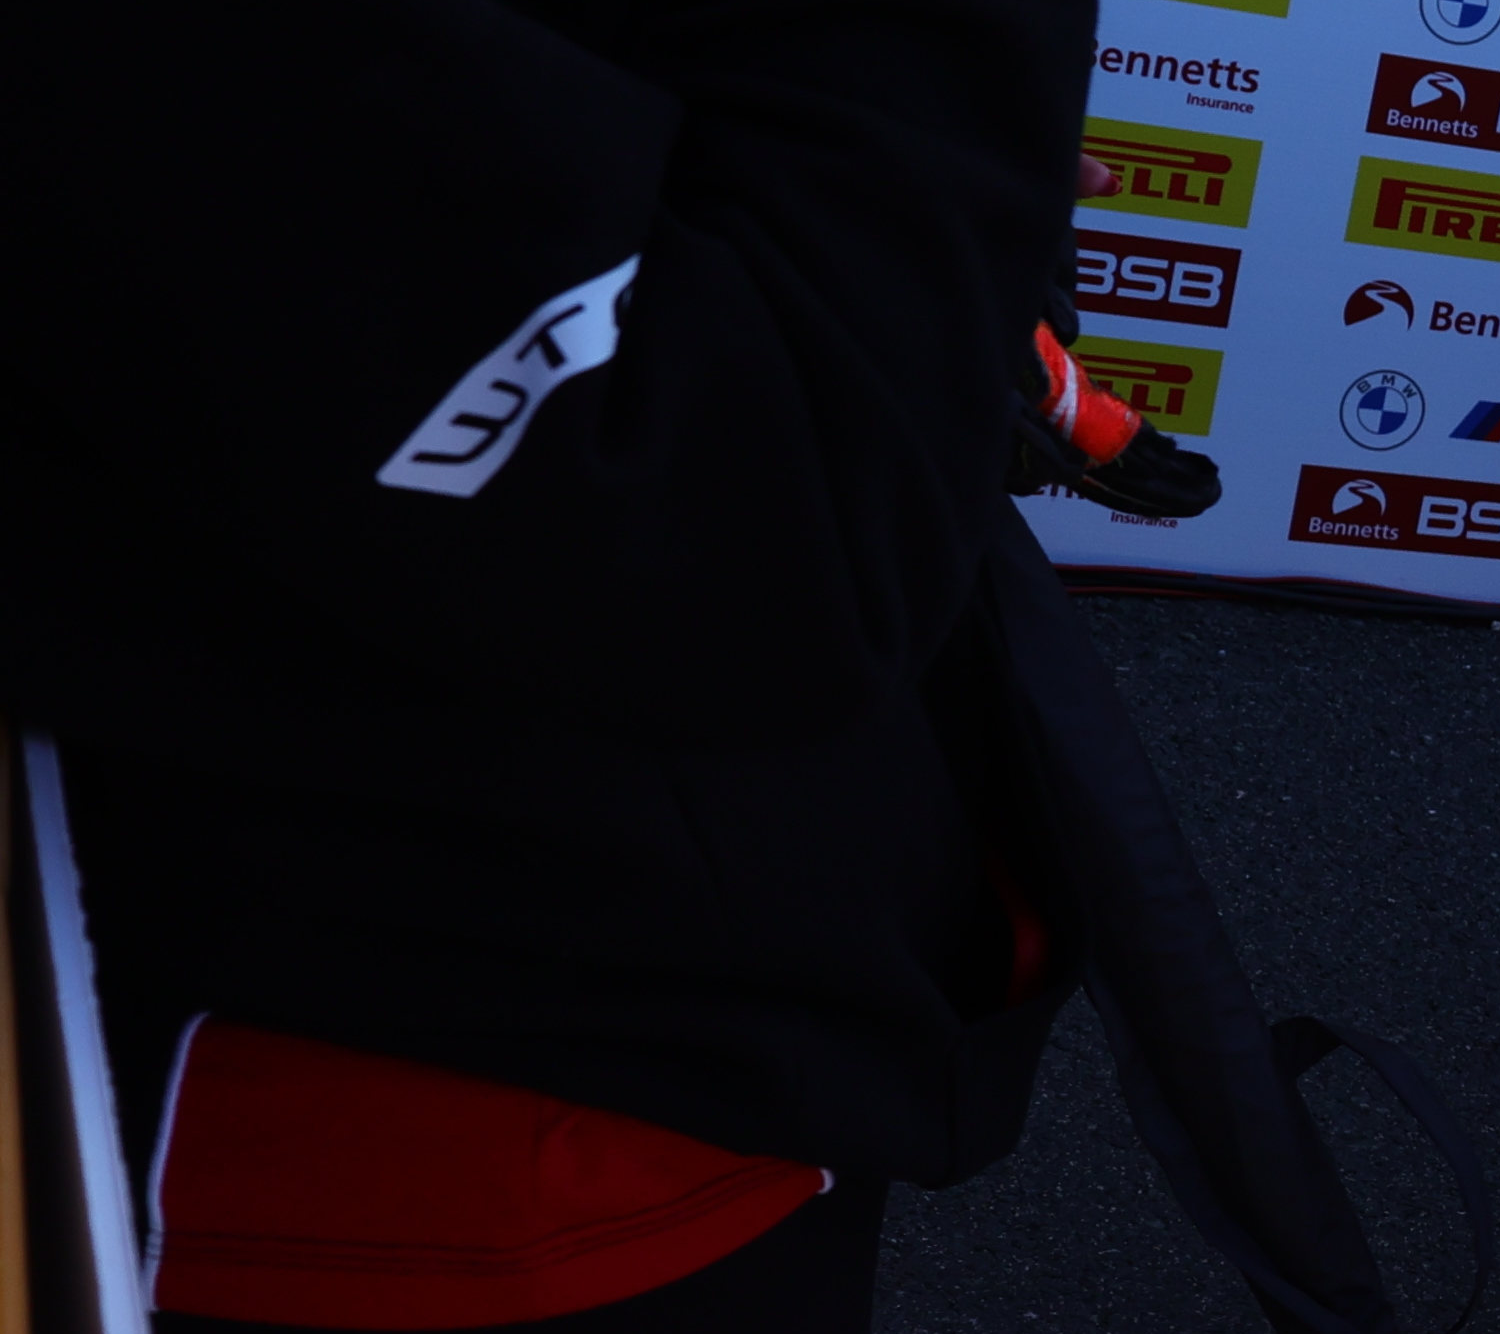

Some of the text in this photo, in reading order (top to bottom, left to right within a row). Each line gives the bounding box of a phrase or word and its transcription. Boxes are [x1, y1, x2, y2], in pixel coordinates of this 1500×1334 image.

[1187, 92, 1254, 115] Insurance
[1386, 108, 1479, 139] Bennetts
[1358, 375, 1418, 400] BMW
[1307, 515, 1399, 542] Bennetts
